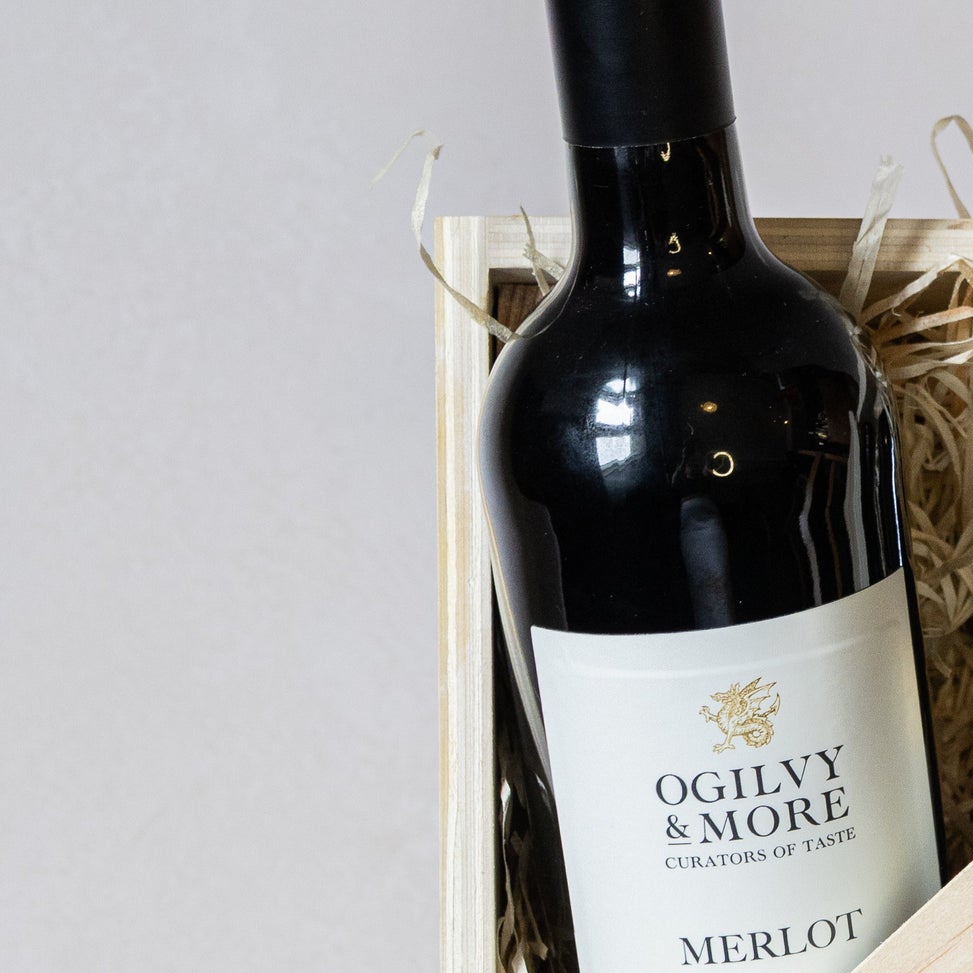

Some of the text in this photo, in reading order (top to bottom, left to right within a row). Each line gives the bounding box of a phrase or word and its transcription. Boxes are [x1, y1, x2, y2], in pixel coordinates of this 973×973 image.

[655, 744, 844, 806] OGILVY
[665, 826, 857, 870] CURATORS OF TASTE
[679, 908, 863, 966] MERLOT
